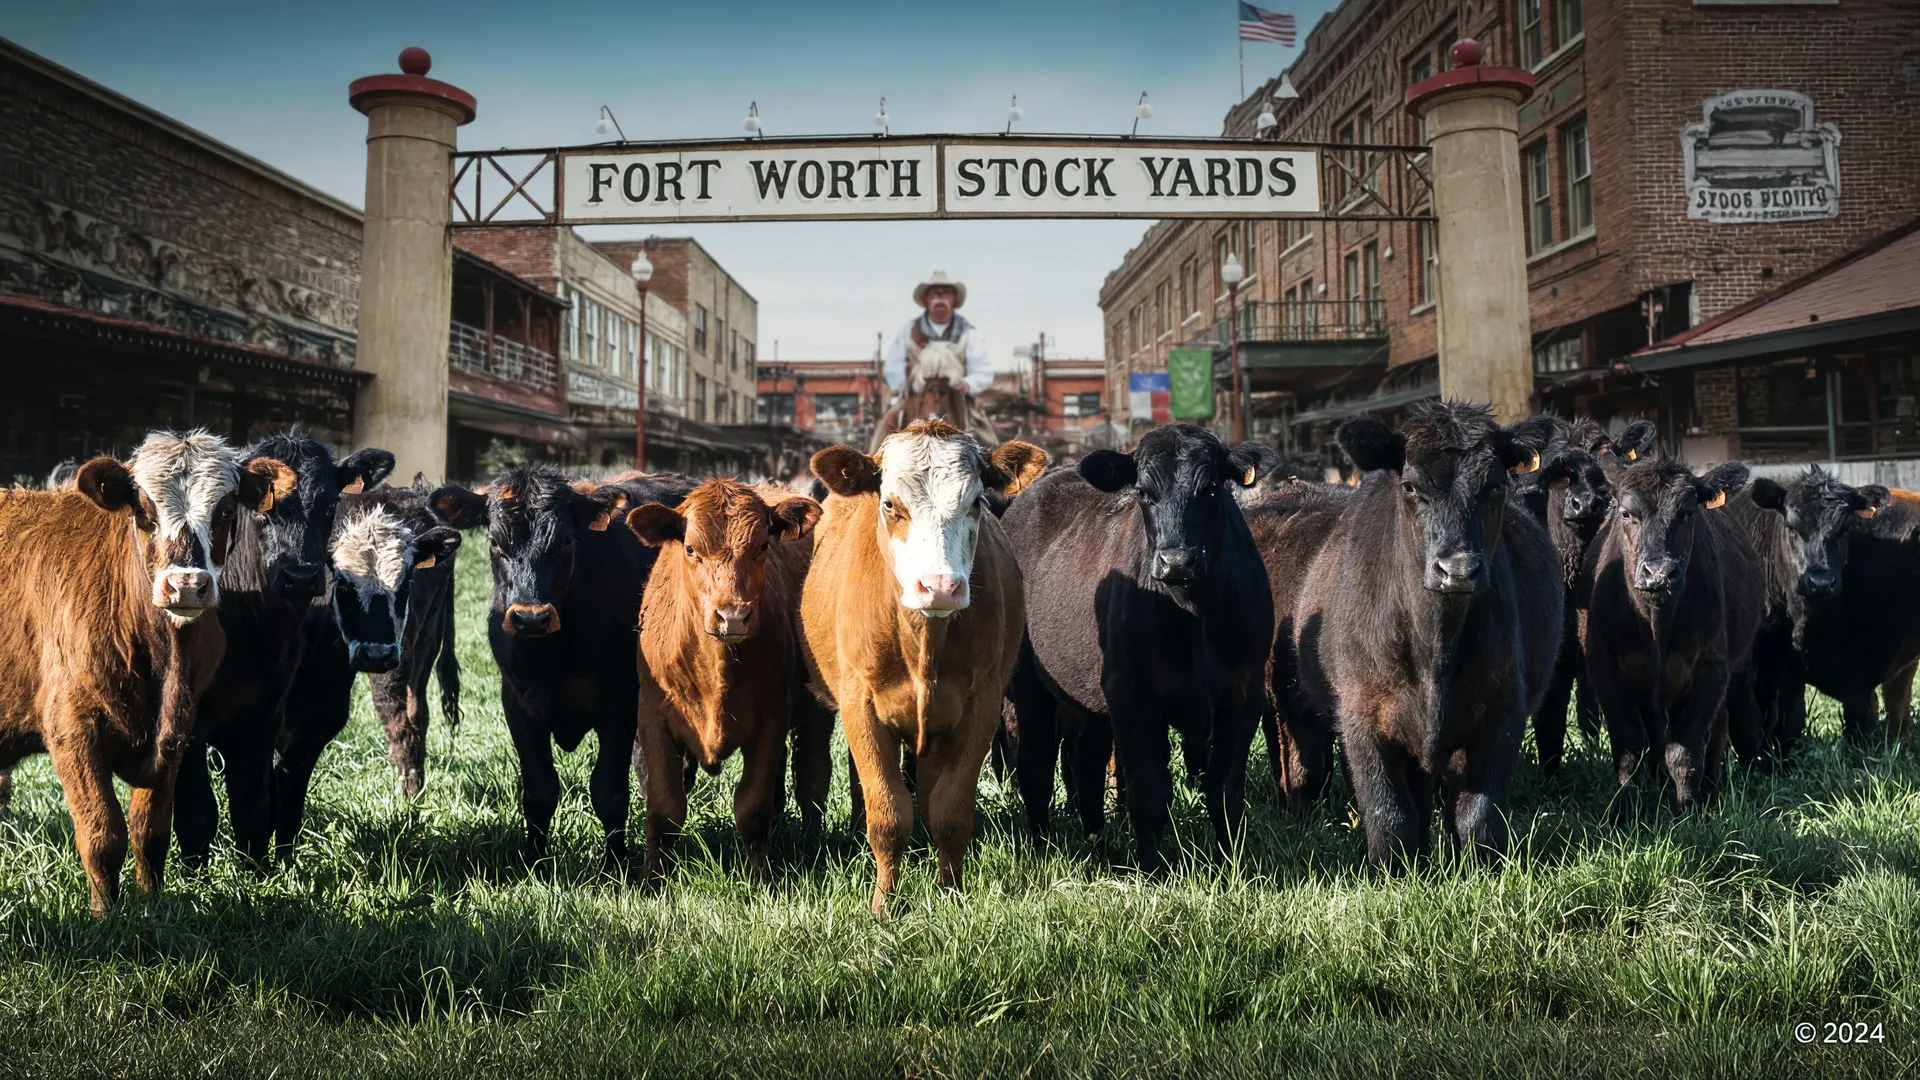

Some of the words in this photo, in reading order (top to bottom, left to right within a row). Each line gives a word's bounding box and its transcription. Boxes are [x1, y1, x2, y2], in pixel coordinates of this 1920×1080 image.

[588, 159, 721, 202] FORT
[750, 159, 922, 200] WORTH
[957, 157, 1117, 197] STOCK
[1139, 156, 1297, 197] YARDS
